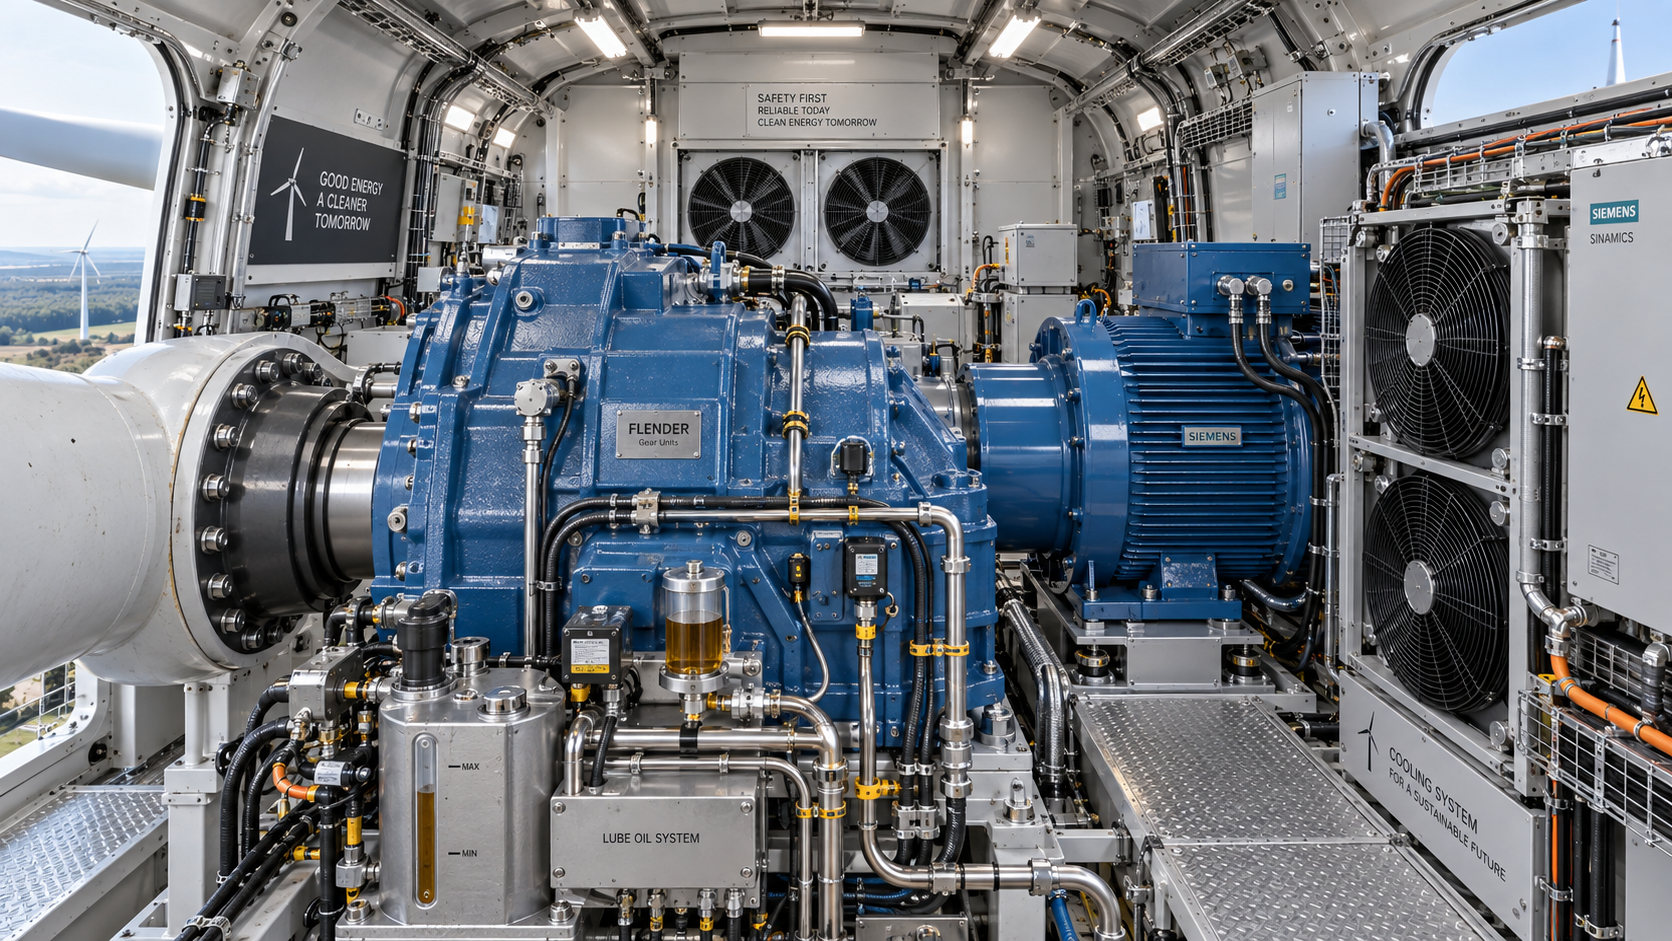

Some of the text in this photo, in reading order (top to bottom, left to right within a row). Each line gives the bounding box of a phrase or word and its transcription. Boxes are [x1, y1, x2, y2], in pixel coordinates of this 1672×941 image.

[757, 93, 827, 103] SAFETY FIRST
[758, 106, 830, 115] RELIABLE TODAY
[757, 118, 877, 127] CLEAN ENERGY TOMORROW
[319, 171, 383, 196] GOOD ENERGY
[316, 192, 368, 212] A CLEANER
[1592, 205, 1636, 220] SIEMENS
[315, 213, 371, 231] TOMORROW
[1590, 231, 1634, 245] SINAMICS
[629, 423, 690, 435] FLENDER
[1189, 431, 1236, 441] SIEMENS
[1389, 747, 1478, 834] COOLING SYSTEM
[1389, 767, 1506, 882] FOR A SUSTAINABLE FUTURE
[603, 833, 700, 844] LUBE OIL SYSTEM
[462, 849, 477, 857] MIN
